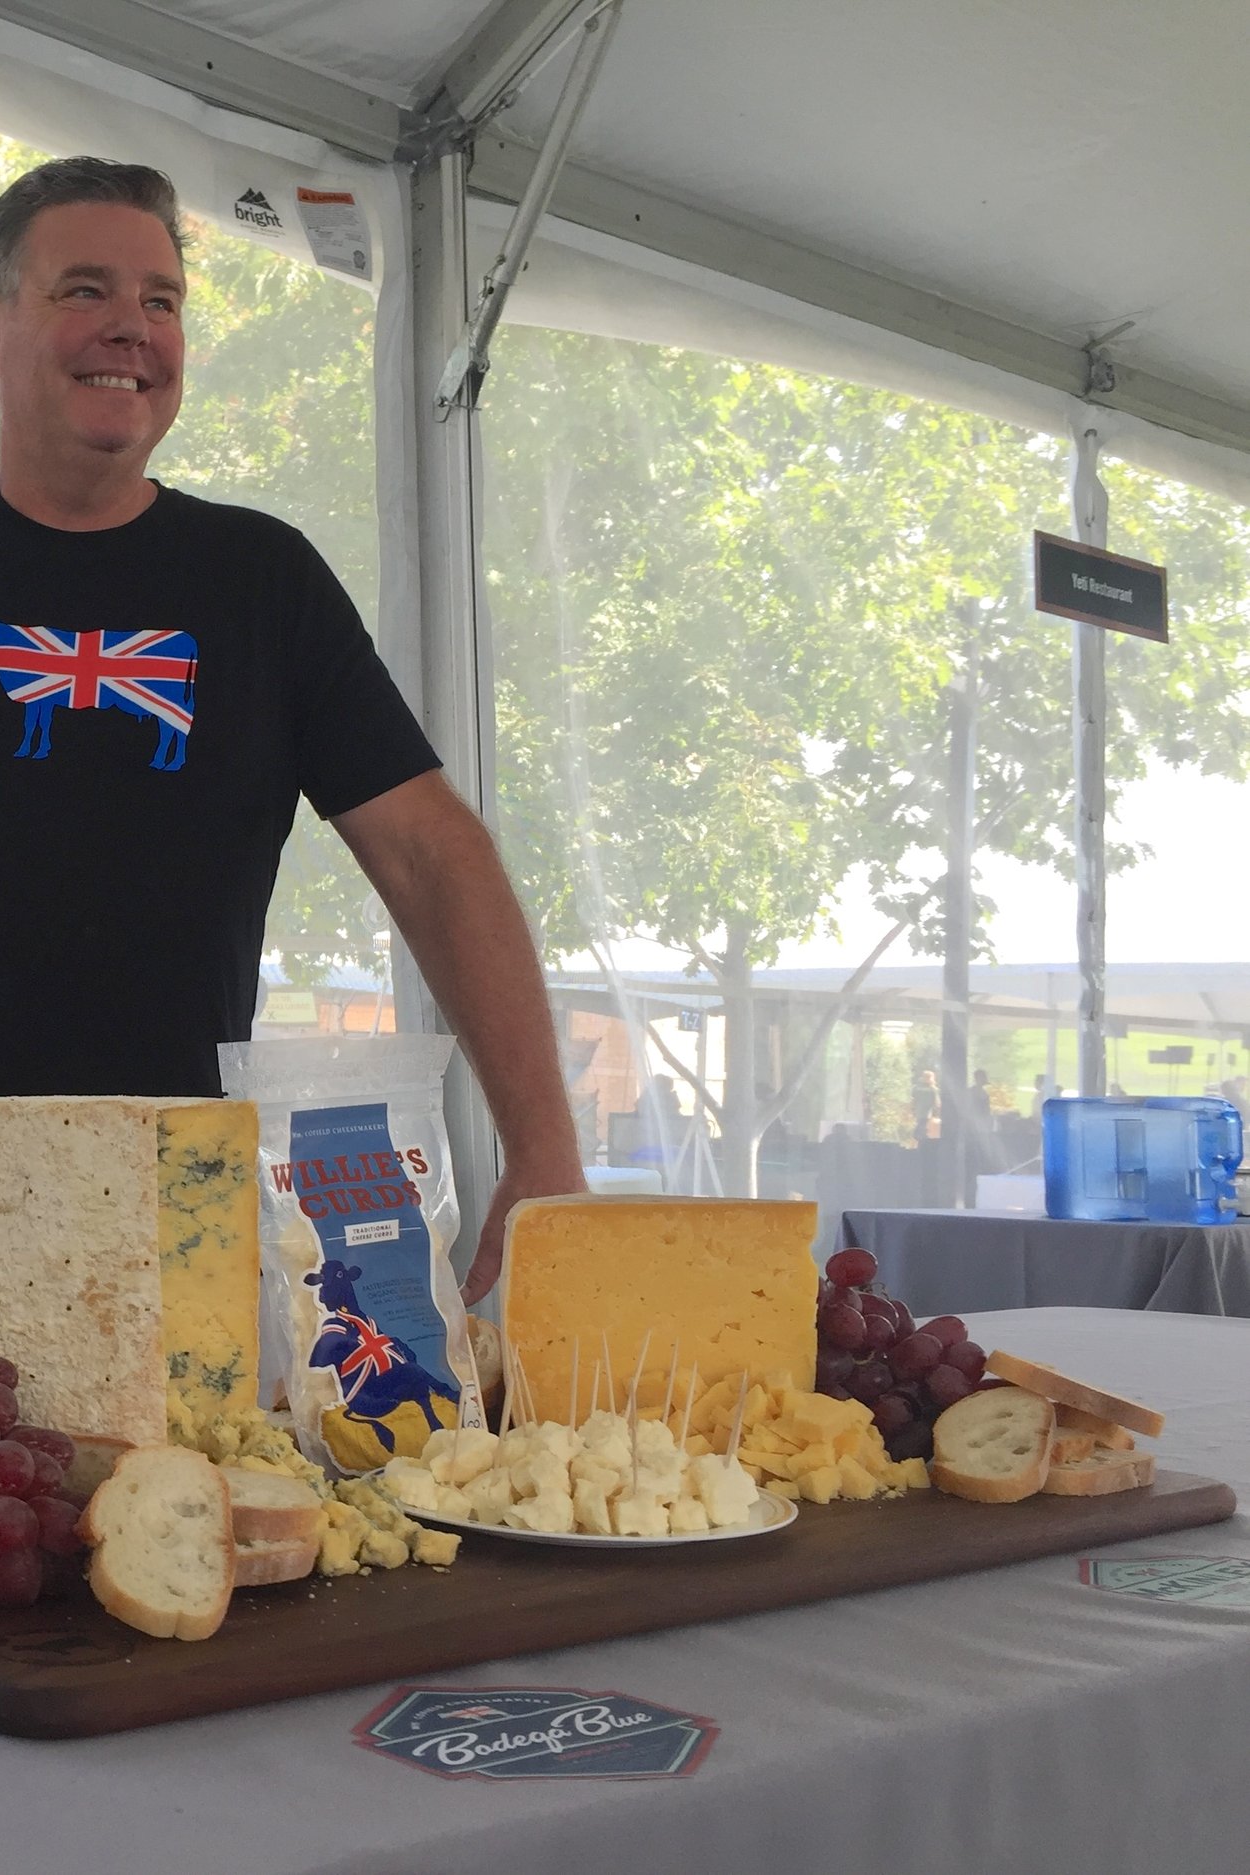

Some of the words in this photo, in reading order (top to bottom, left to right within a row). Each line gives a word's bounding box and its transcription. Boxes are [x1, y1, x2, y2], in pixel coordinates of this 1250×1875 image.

[234, 202, 283, 228] bright
[1071, 572, 1089, 591] Yeti
[1089, 577, 1133, 604] Restaurant
[304, 1128, 331, 1137] COFIELD
[332, 1123, 385, 1135] CHEESEMAKERS
[270, 1148, 428, 1194] WILLIE'S
[299, 1180, 422, 1219] CURDS
[351, 1233, 372, 1241] CHEESE
[374, 1230, 393, 1239] CURDS
[353, 1224, 391, 1234] TRADITIONAL
[412, 1726, 574, 1765] Bodega
[550, 1705, 652, 1737] Blue
